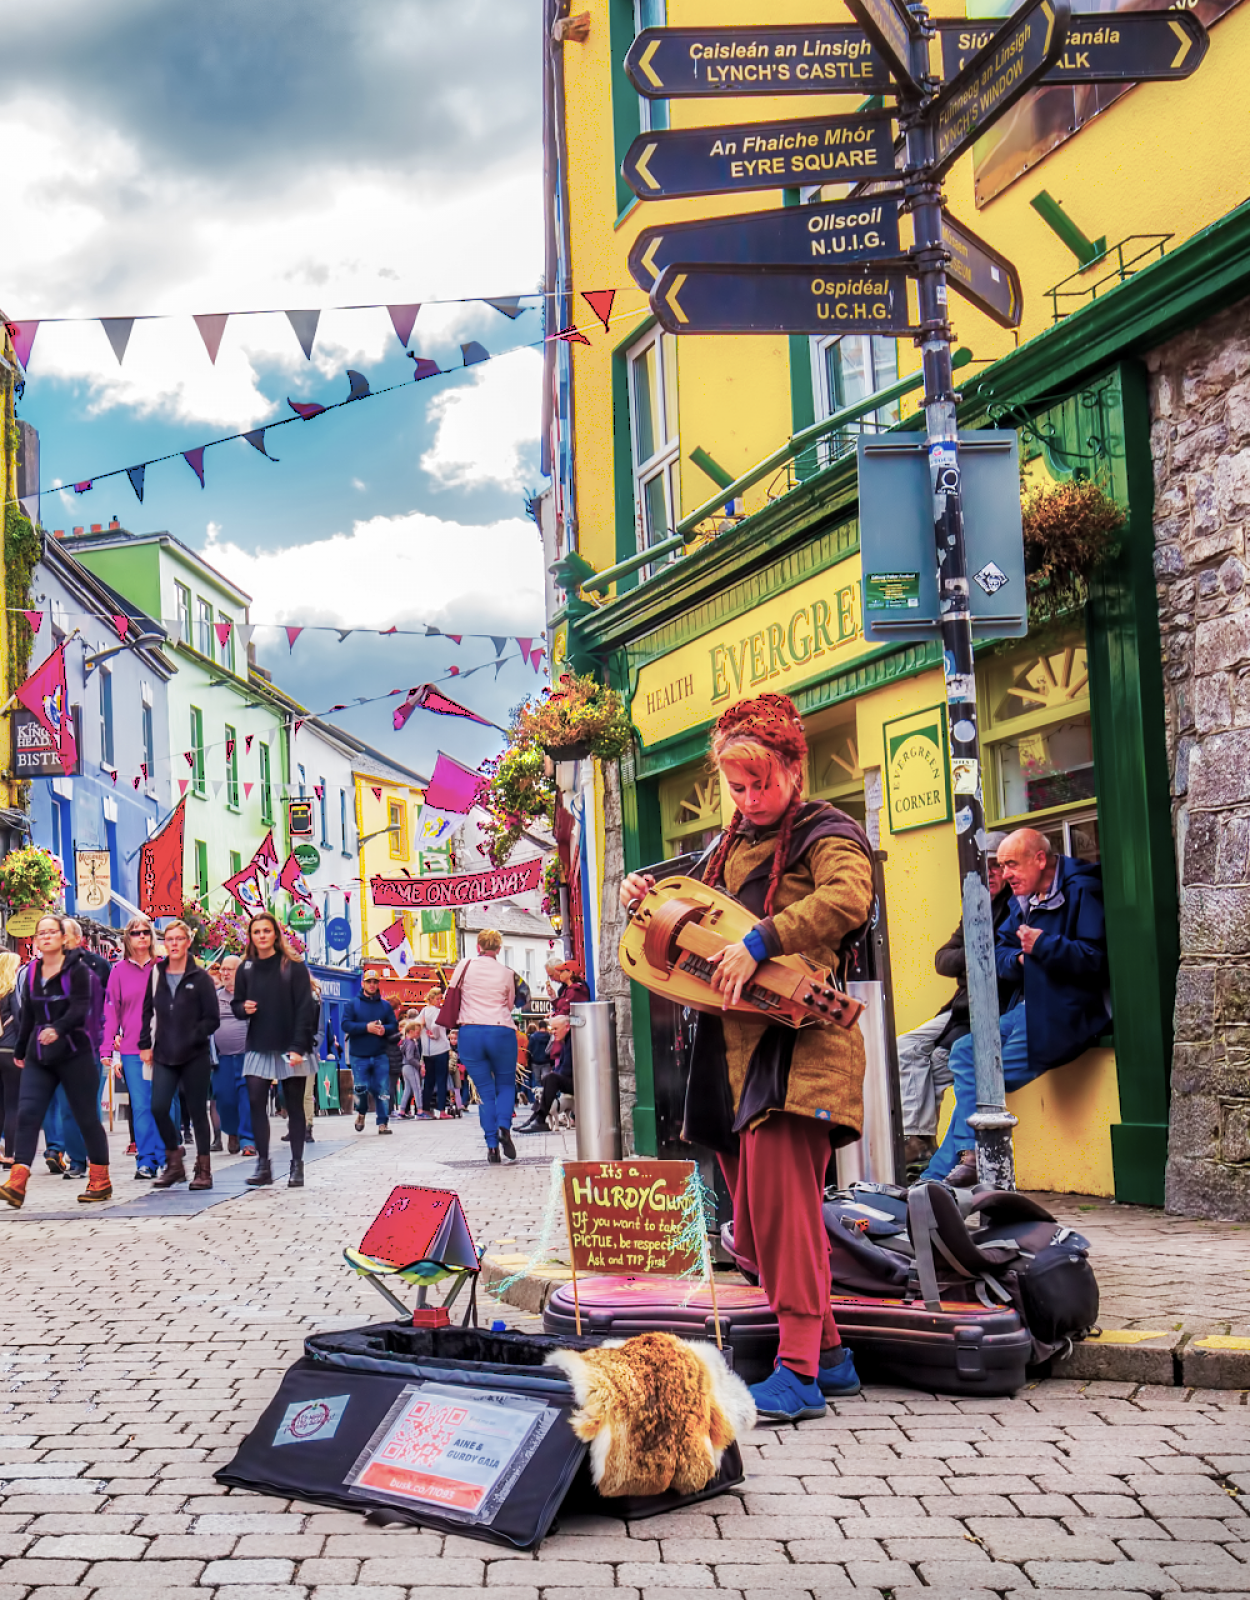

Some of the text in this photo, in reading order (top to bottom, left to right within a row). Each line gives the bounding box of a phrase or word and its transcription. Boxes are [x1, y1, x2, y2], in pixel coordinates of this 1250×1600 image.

[690, 39, 871, 60] Caisleán an Linsigh
[981, 65, 993, 86] an
[995, 24, 1031, 71] Linsigh
[1056, 52, 1091, 69] ALK
[707, 62, 873, 81] LYNCH'S CASTLE
[980, 56, 1024, 112] WINDOW
[710, 127, 875, 156] An Fhaiche Mhór
[731, 149, 877, 178] EYRE SQUARE
[808, 207, 882, 233] Ollscoil
[811, 232, 886, 256] N.U.I.G.
[811, 279, 889, 299] Ospidéal
[816, 303, 892, 320] U.C.H.G.
[646, 673, 695, 716] HEALTH
[17, 725, 49, 737] KING
[17, 752, 61, 766] BISTR
[893, 745, 940, 791] EVERGREEN
[895, 789, 941, 814] CORNER
[374, 869, 532, 904] OME ON GALWAY
[572, 1211, 588, 1234] If
[590, 1217, 610, 1235] you
[613, 1216, 640, 1230] want
[644, 1218, 656, 1231] to
[620, 1233, 631, 1249] be
[587, 1251, 606, 1267] Ask
[608, 1253, 623, 1265] and
[626, 1254, 644, 1266] TIP
[446, 1449, 500, 1469] GURDY GAIA
